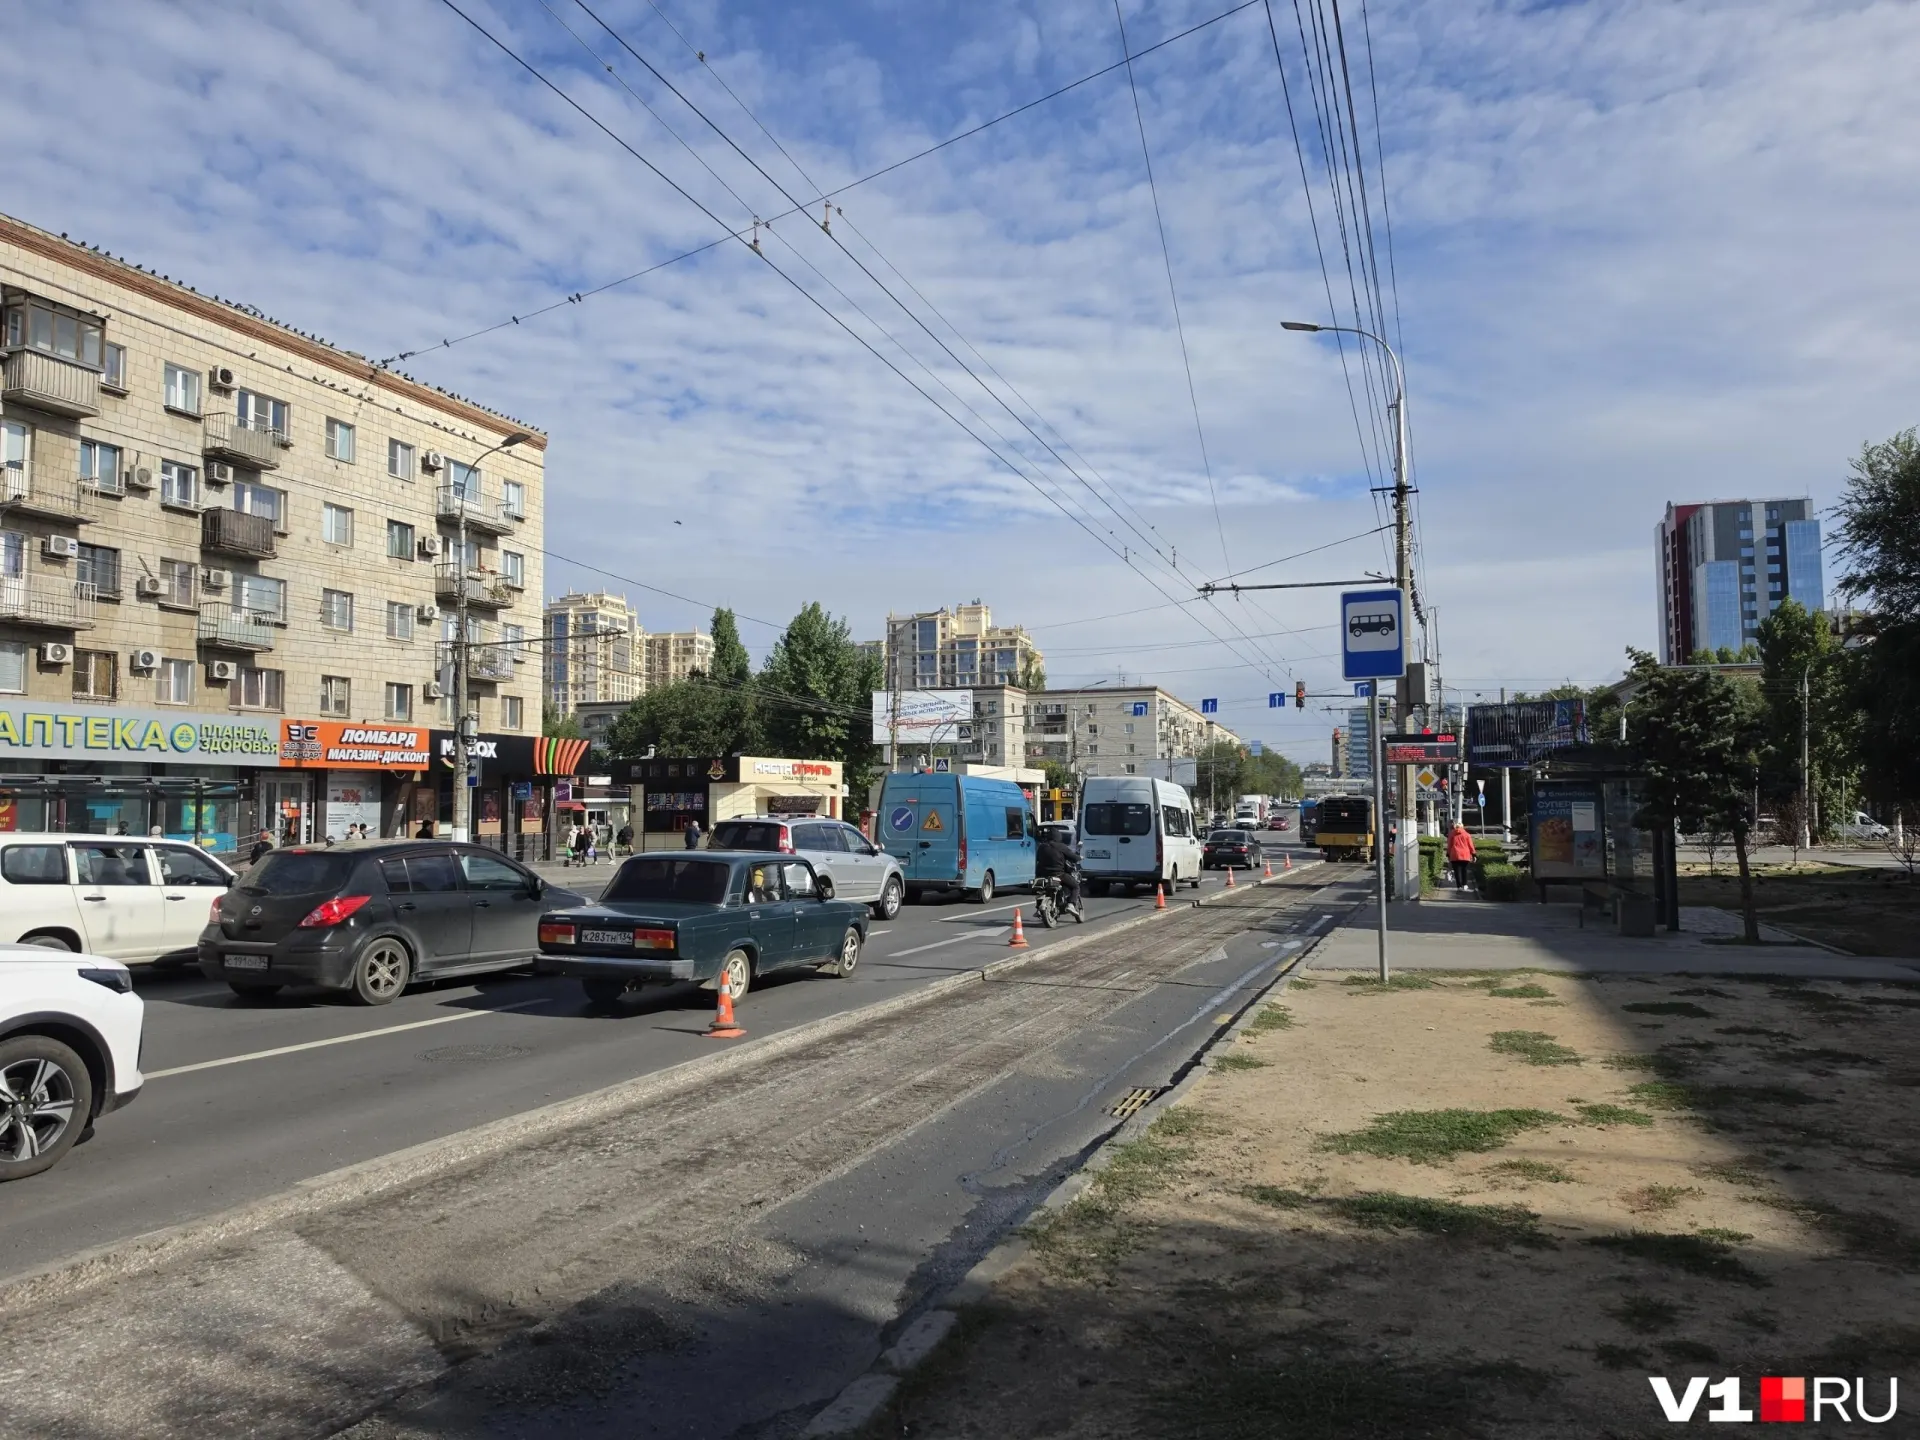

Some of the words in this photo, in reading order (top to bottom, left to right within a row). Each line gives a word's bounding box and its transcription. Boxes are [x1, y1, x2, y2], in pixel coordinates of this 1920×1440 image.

[0, 710, 170, 752] АПТЕКА
[200, 724, 270, 741] ПЛАНЕТА
[339, 728, 418, 749] ЛОМБАРД
[199, 738, 279, 755] ЗДОРОВЬЯ
[281, 751, 323, 761] СТАНДАРТ
[326, 748, 430, 765] МАГАЗИН-ДИСКОНТ
[584, 932, 617, 942] К283ТН
